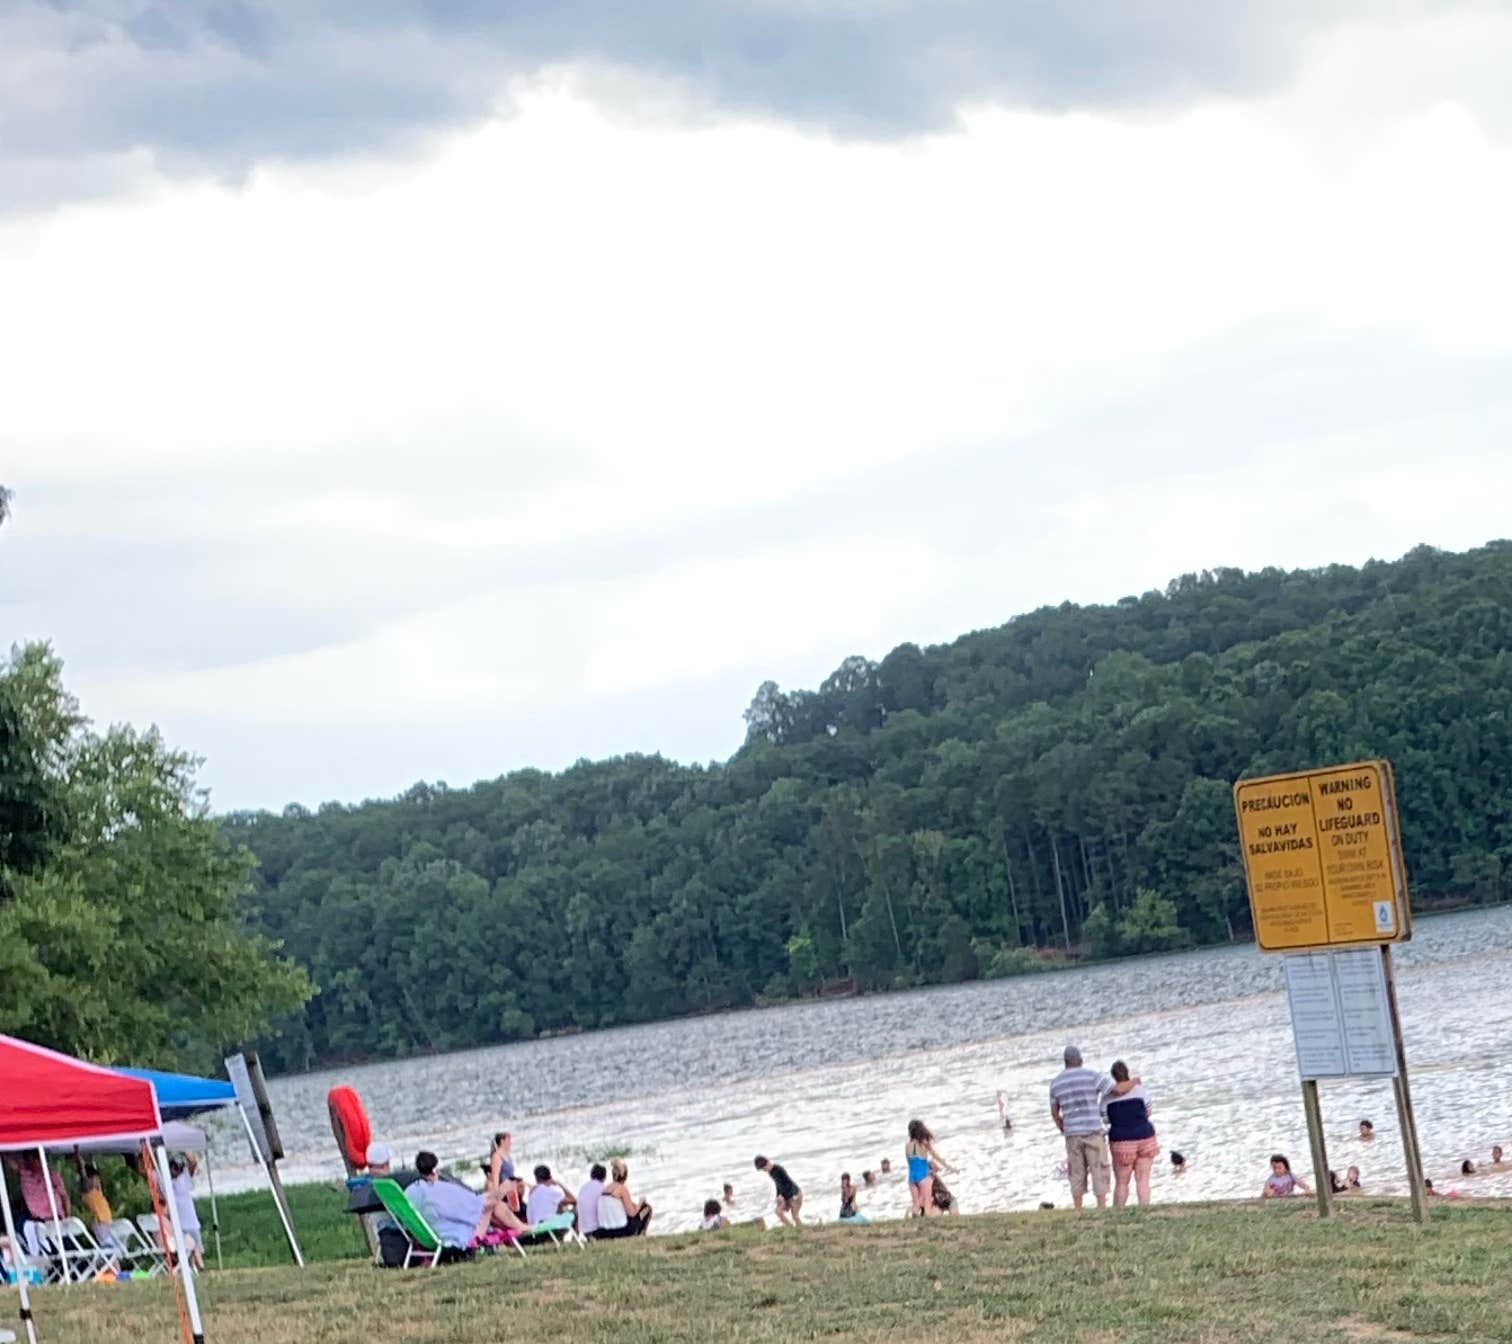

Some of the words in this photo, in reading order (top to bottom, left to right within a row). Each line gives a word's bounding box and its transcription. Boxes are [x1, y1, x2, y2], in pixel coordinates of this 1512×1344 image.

[1319, 777, 1371, 795] WARNING
[1242, 793, 1309, 812] PRECAUCION
[1337, 798, 1353, 811] NO
[1258, 826, 1272, 838] NO
[1275, 823, 1297, 837] HAY
[1319, 813, 1379, 832] LIFEGUARD
[1249, 838, 1313, 855] SALVAVIDAS
[1331, 833, 1345, 846] ON
[1346, 830, 1369, 846] DUTY
